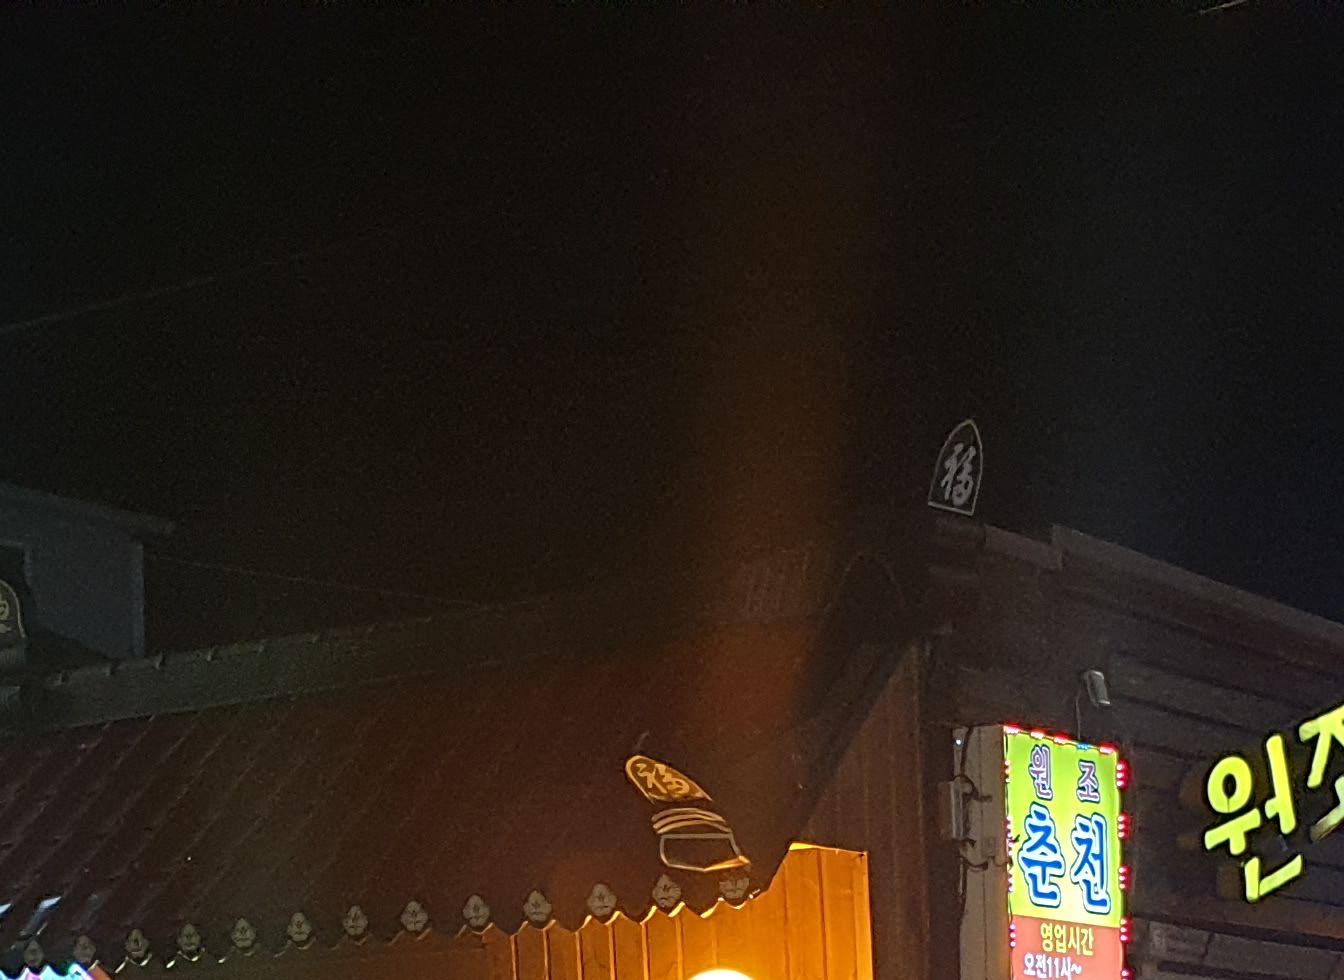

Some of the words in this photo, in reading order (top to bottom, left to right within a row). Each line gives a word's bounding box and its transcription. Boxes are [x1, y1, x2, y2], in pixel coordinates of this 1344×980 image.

[1028, 744, 1101, 804] 원조
[1017, 801, 1112, 915] 춘천
[1040, 922, 1095, 957] 영업시간
